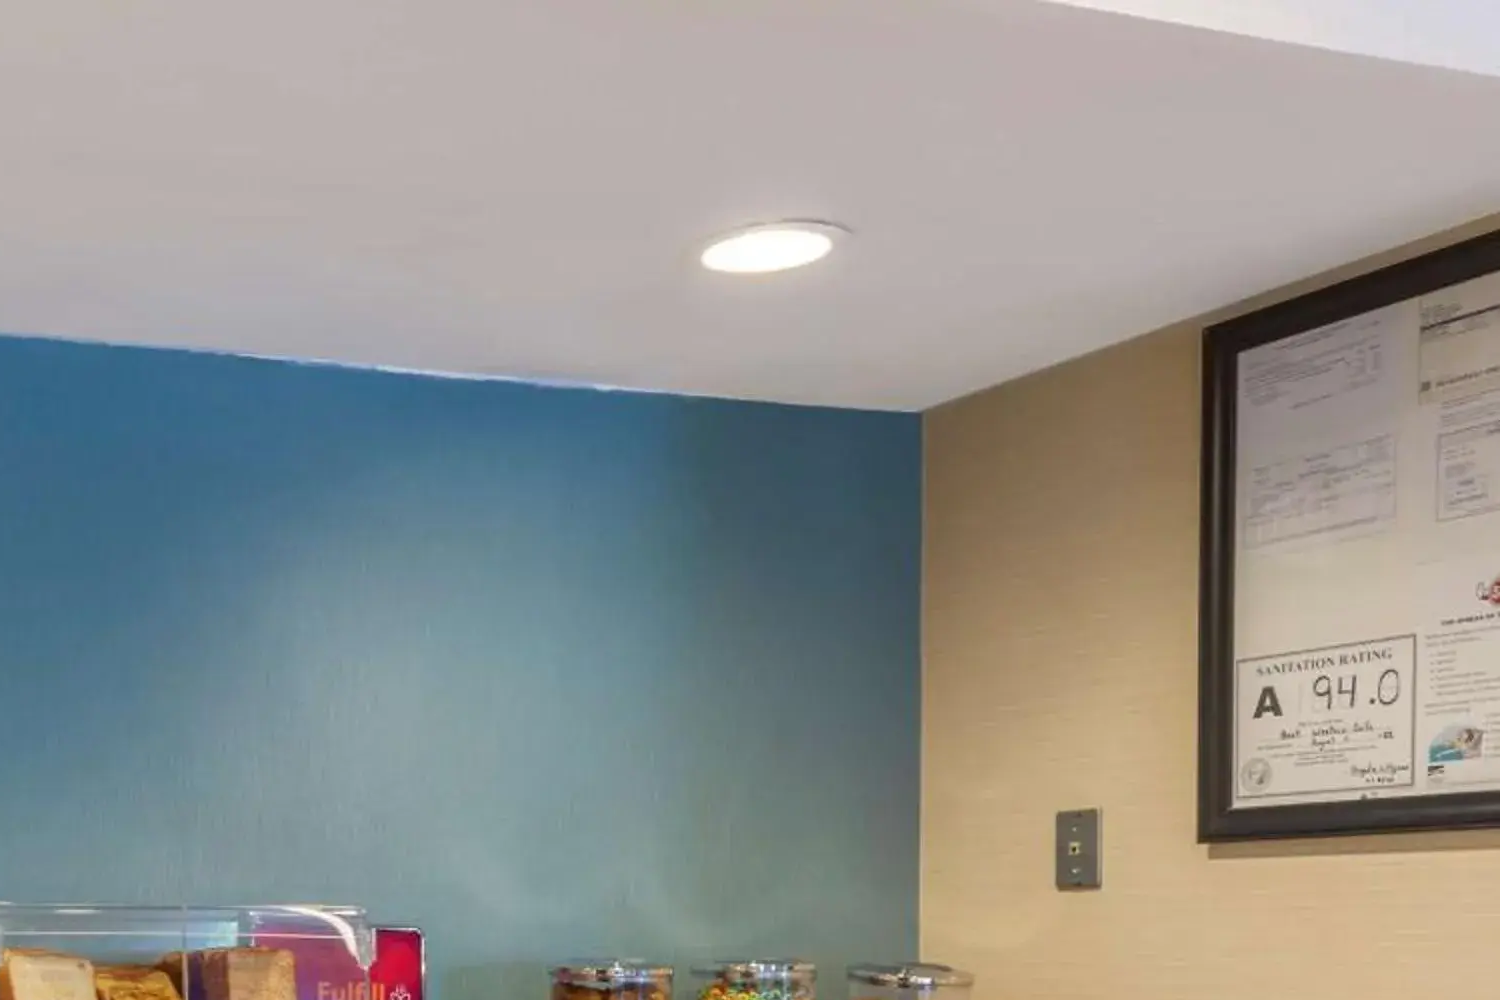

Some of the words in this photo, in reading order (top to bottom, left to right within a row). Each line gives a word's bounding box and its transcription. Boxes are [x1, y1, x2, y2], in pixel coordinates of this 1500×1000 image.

[1256, 656, 1335, 676] SANITATION
[1339, 647, 1393, 666] RATING
[1252, 685, 1284, 719] A
[1312, 669, 1400, 710] 94.0
